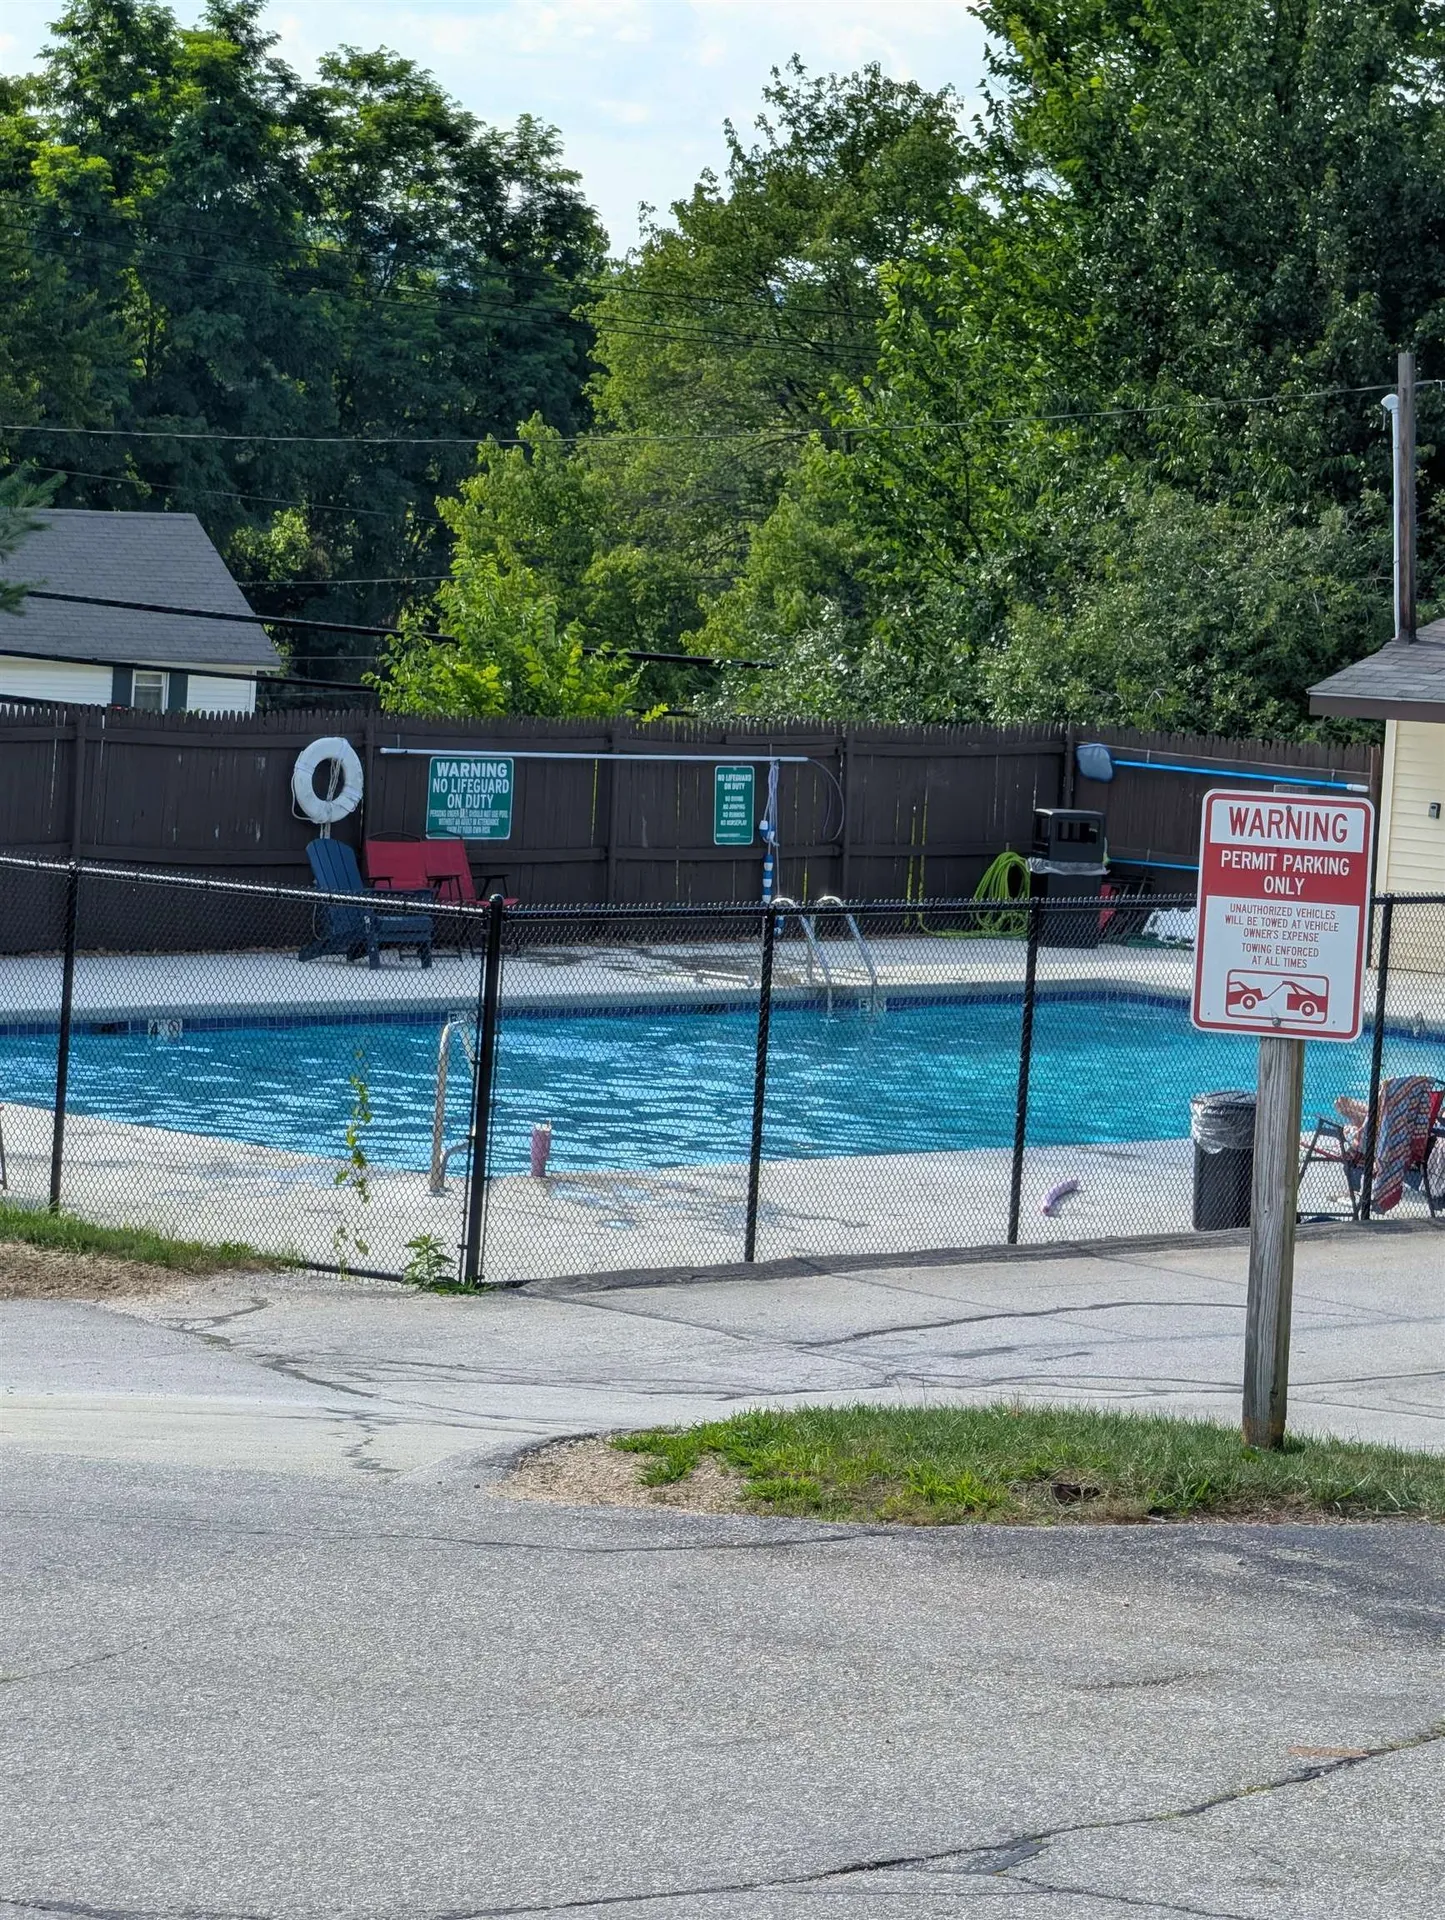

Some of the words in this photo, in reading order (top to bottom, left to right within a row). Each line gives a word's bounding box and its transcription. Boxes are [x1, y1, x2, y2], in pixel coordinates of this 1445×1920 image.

[437, 762, 507, 778] WARNING
[432, 778, 448, 793] NO
[451, 778, 509, 793] LIFEGUARD
[447, 794, 461, 808] ON
[465, 794, 494, 808] DUTY
[1229, 806, 1348, 843] WARNING
[1221, 850, 1277, 871] PERMIT
[1283, 854, 1350, 876] PARKING
[1264, 876, 1305, 896] ONLY
[1230, 903, 1292, 916] UNAUTHORIZED
[1296, 908, 1336, 920] VEHICLES
[1225, 915, 1243, 925] WILL
[1247, 916, 1258, 926] BE
[1261, 918, 1288, 928] TOWED
[1291, 920, 1301, 929] AT
[1304, 921, 1339, 932] VEHICLE
[1243, 928, 1279, 939] OWNER'S
[1282, 931, 1319, 942] EXPENSE
[1242, 942, 1272, 953] TOWING
[1276, 945, 1319, 957] ENFORCED
[1252, 956, 1262, 965] AT
[1264, 957, 1280, 966] ALL
[1284, 958, 1308, 968] TIMES
